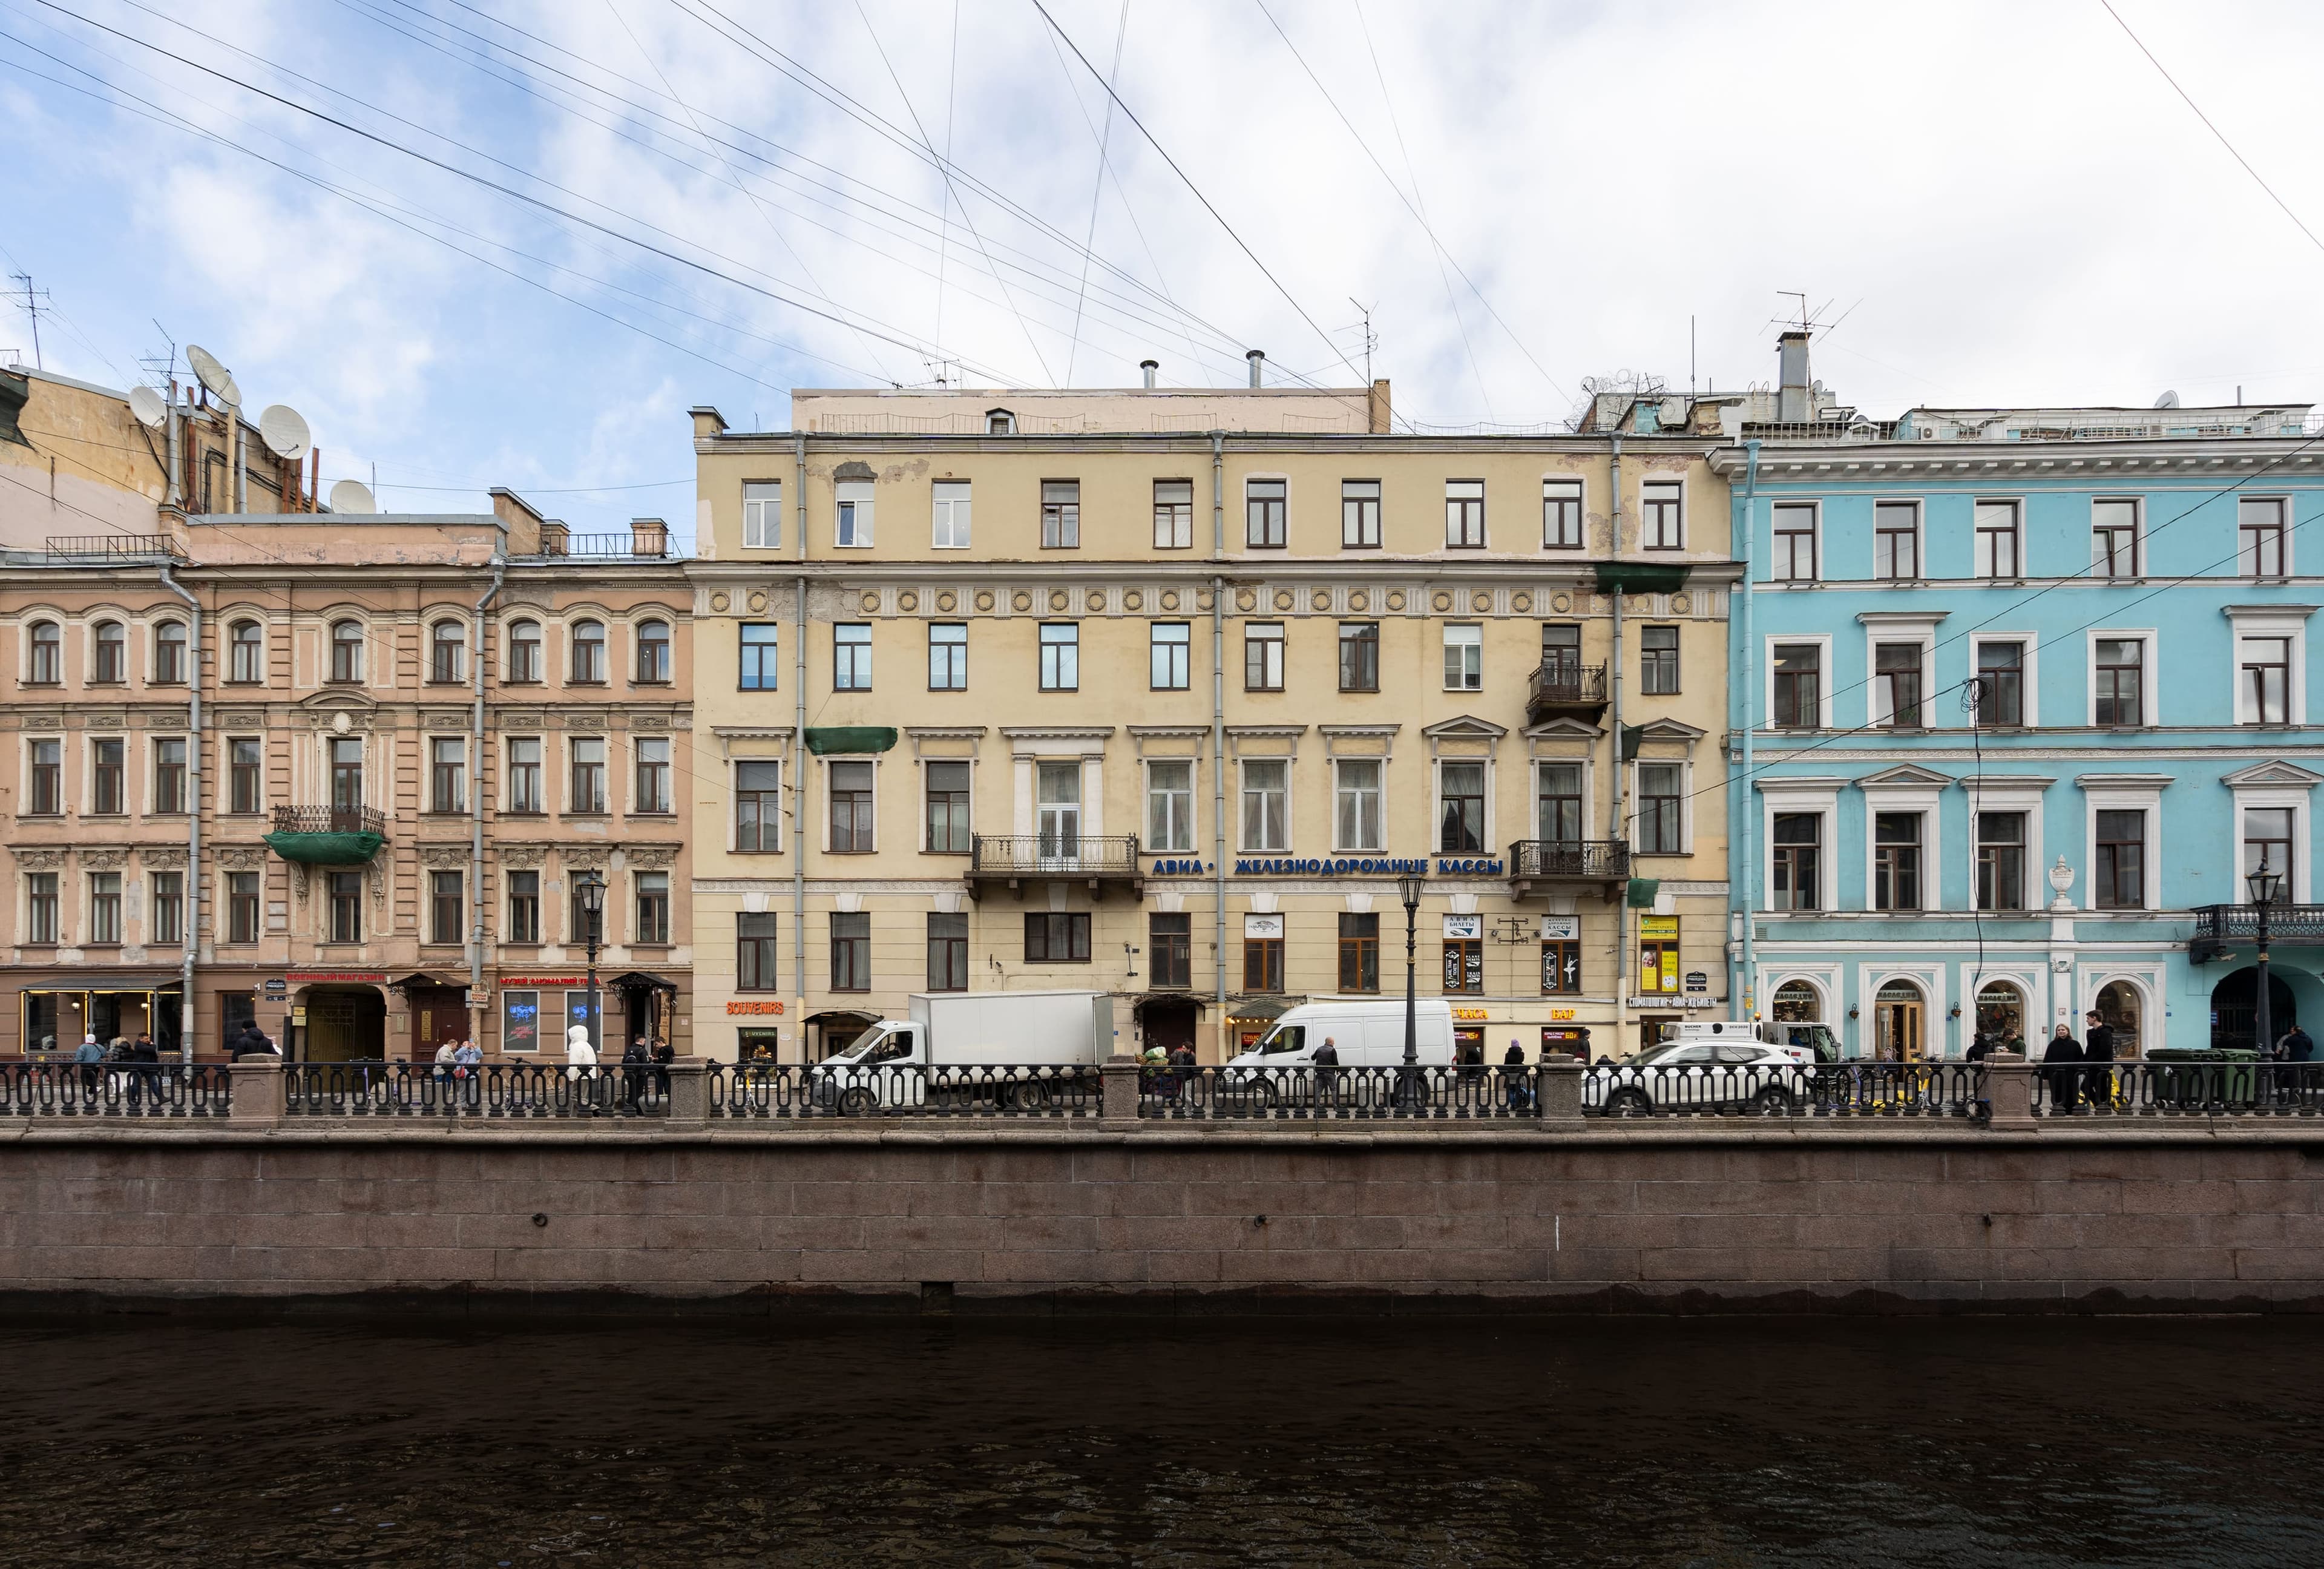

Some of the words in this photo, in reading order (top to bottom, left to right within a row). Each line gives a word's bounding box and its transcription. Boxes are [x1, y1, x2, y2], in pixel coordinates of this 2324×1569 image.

[1152, 860, 1204, 873] АВИА
[1235, 859, 1428, 875] ЖЕЛЕЗНОДОРОЖНЫЕ
[1438, 859, 1503, 873] КАССЫ
[727, 1001, 783, 1015] SOUVENIRS
[1629, 997, 1667, 1007] СТОМАТОЛОГИЯ
[1457, 1007, 1488, 1019] ЧАСА
[1551, 1008, 1575, 1019] БАР
